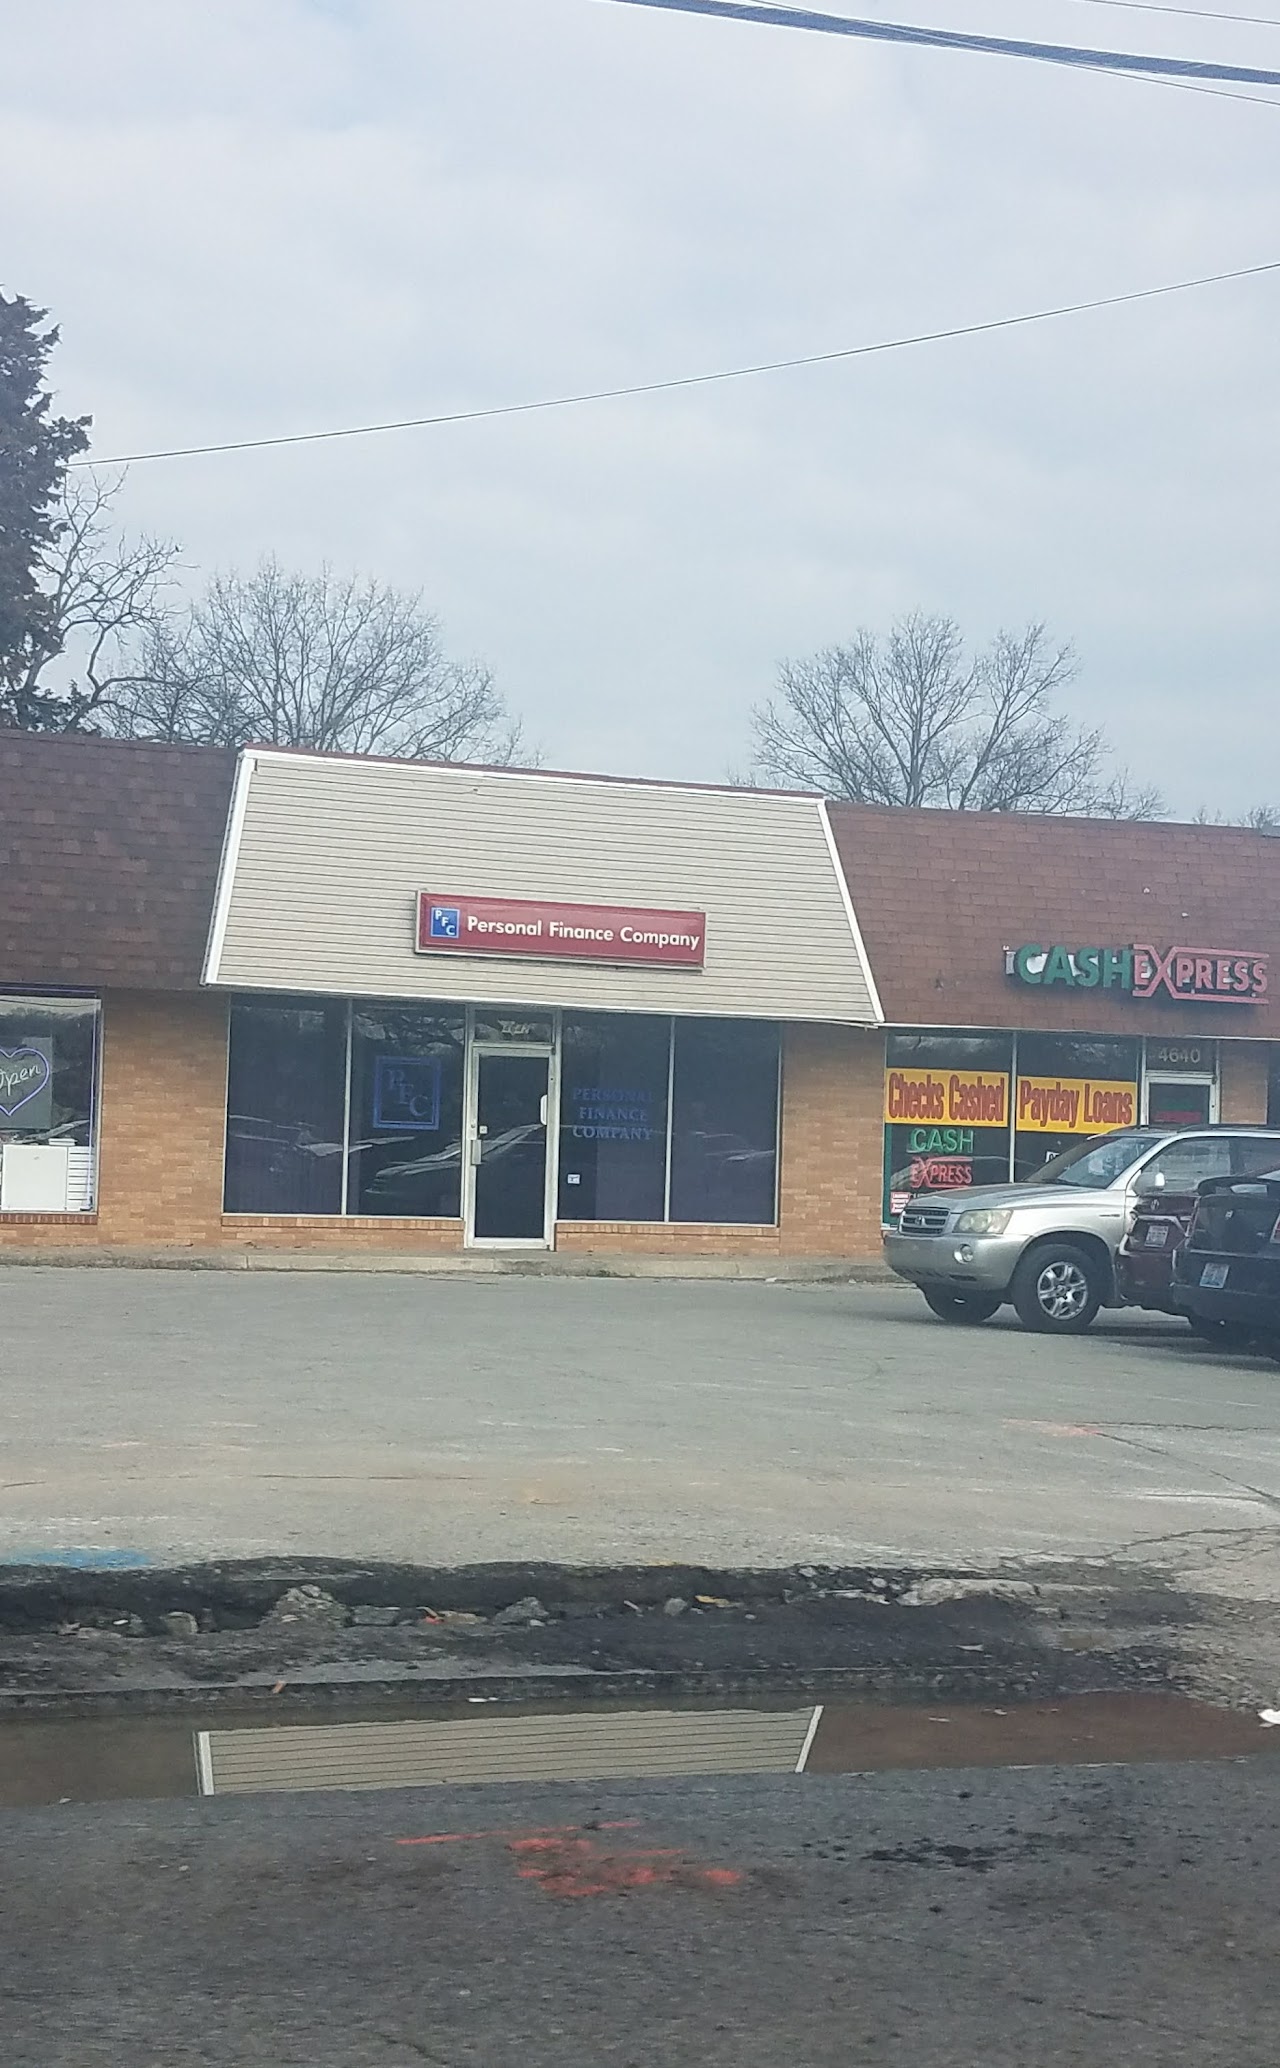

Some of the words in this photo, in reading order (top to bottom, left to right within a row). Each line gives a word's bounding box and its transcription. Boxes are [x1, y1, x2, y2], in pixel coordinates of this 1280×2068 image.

[467, 915, 542, 936] Personal
[549, 921, 614, 942] Finance
[620, 926, 700, 950] Company
[1017, 944, 1133, 989] CASH
[1132, 944, 1269, 1004] EXPRESS
[1158, 1047, 1201, 1064] 4640
[580, 1106, 648, 1121] FINANCE
[888, 1072, 944, 1120] Checks
[949, 1074, 1005, 1122] Cashed
[1019, 1079, 1080, 1128] Payday
[1084, 1083, 1133, 1124] Loans
[572, 1125, 652, 1140] COMPANY
[911, 1127, 974, 1153] CASH
[910, 1154, 973, 1188] EXPRESS
